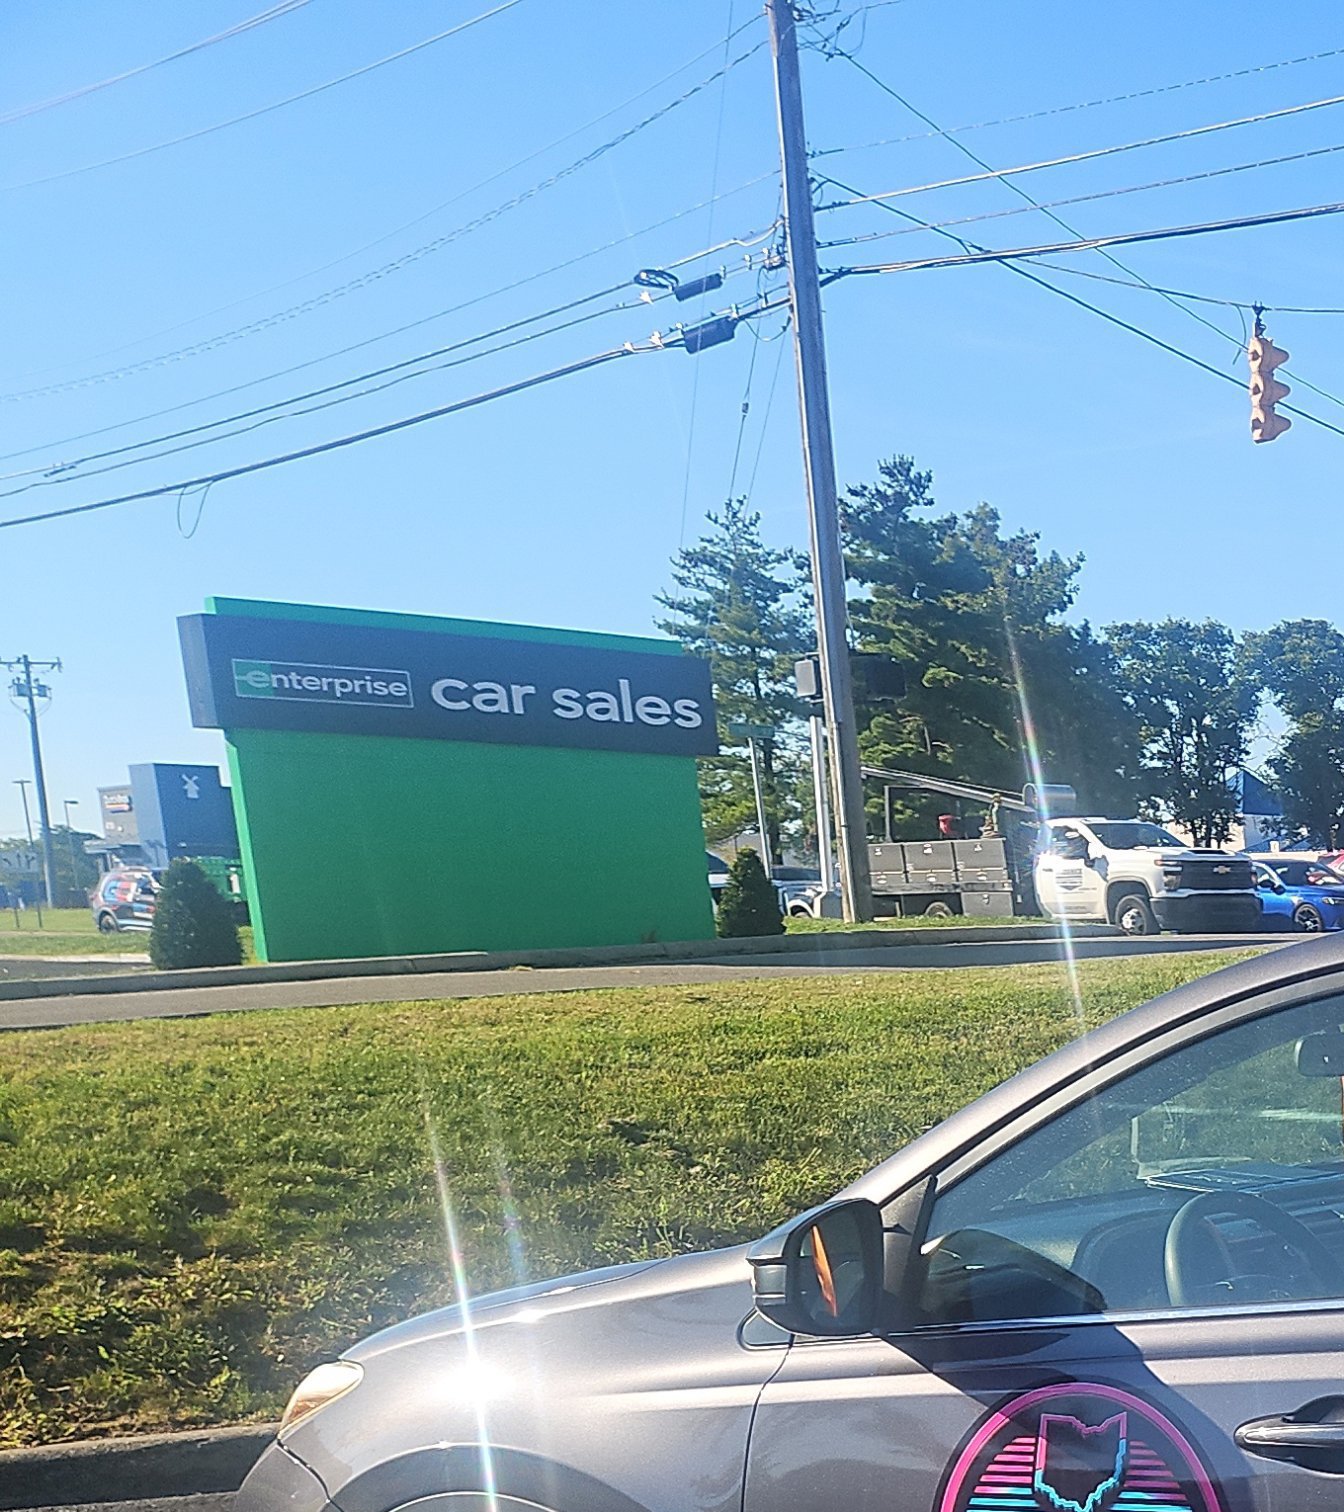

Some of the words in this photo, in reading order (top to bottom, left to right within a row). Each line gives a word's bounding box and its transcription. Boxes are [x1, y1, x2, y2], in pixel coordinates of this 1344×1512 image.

[236, 669, 408, 698] enterprise
[431, 678, 536, 715] car
[551, 678, 703, 729] sales
